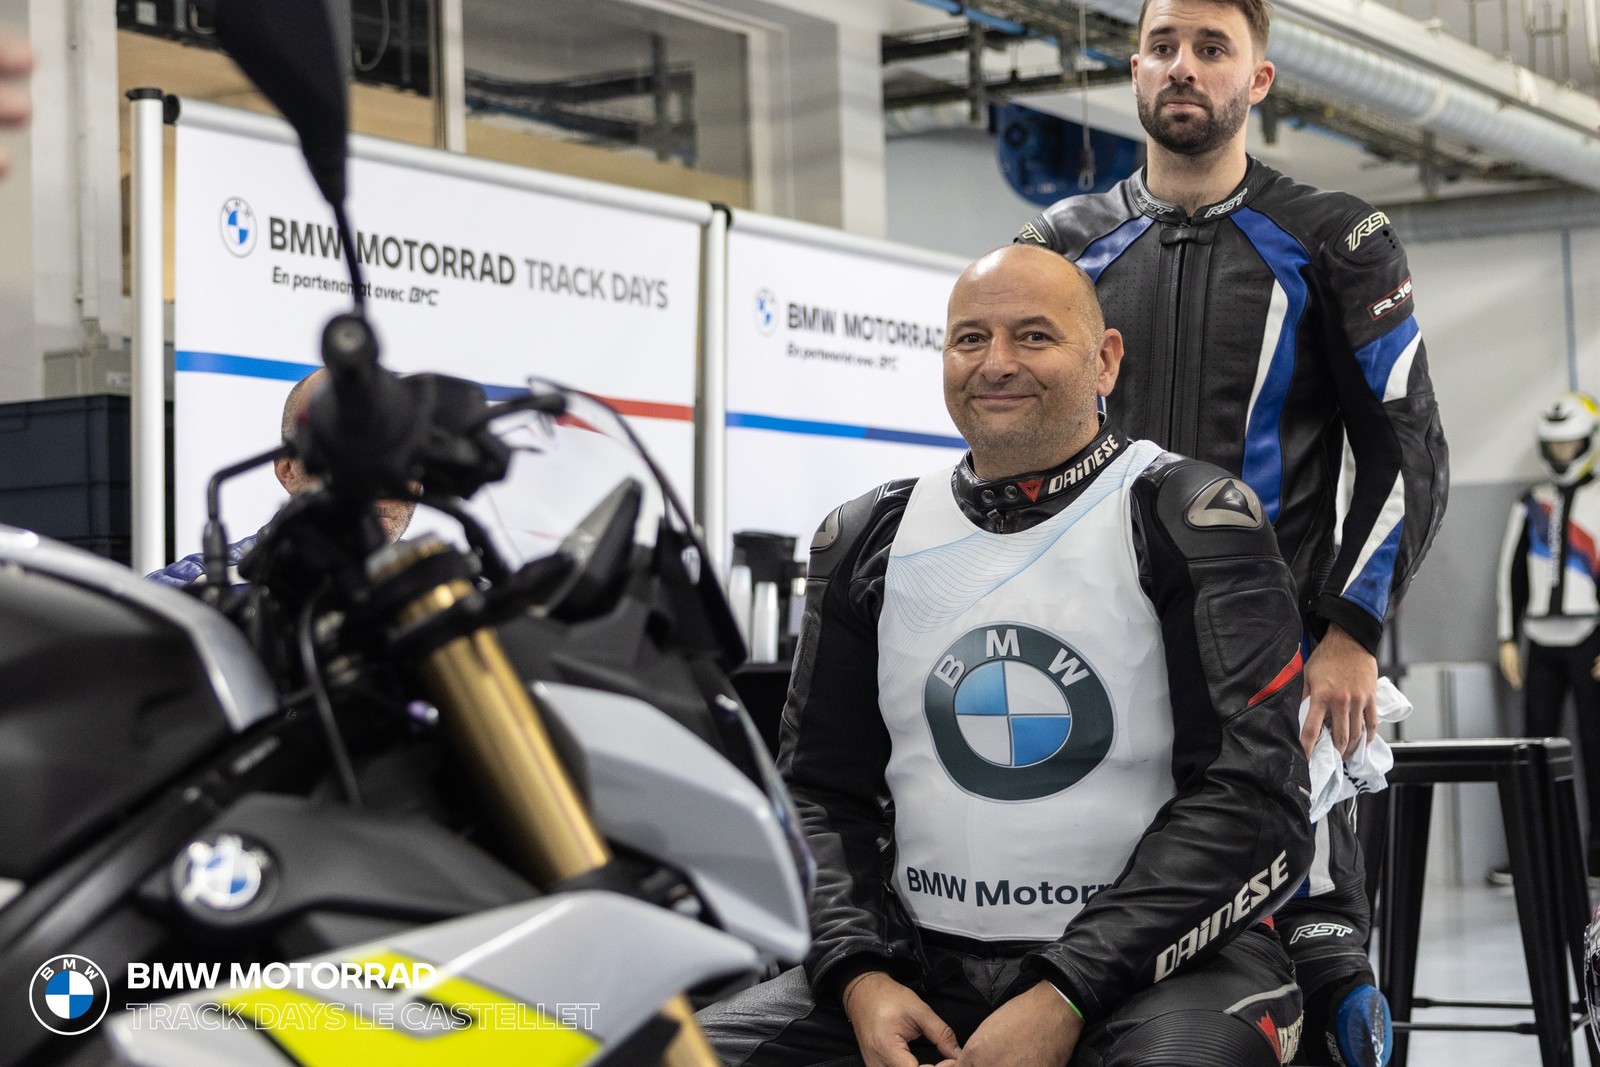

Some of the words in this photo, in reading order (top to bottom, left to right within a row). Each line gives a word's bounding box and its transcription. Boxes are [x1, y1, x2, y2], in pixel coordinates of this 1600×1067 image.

[1204, 187, 1248, 219] RST
[269, 216, 343, 260] BMW
[356, 231, 515, 285] MOTORRAD
[525, 258, 606, 300] TRACK
[612, 272, 668, 309] DAYS
[272, 266, 290, 284] En
[1373, 281, 1413, 316] R-16
[787, 303, 837, 334] BMW
[934, 629, 1090, 688] BMW
[907, 866, 967, 902] BMW
[1290, 922, 1353, 945] RST
